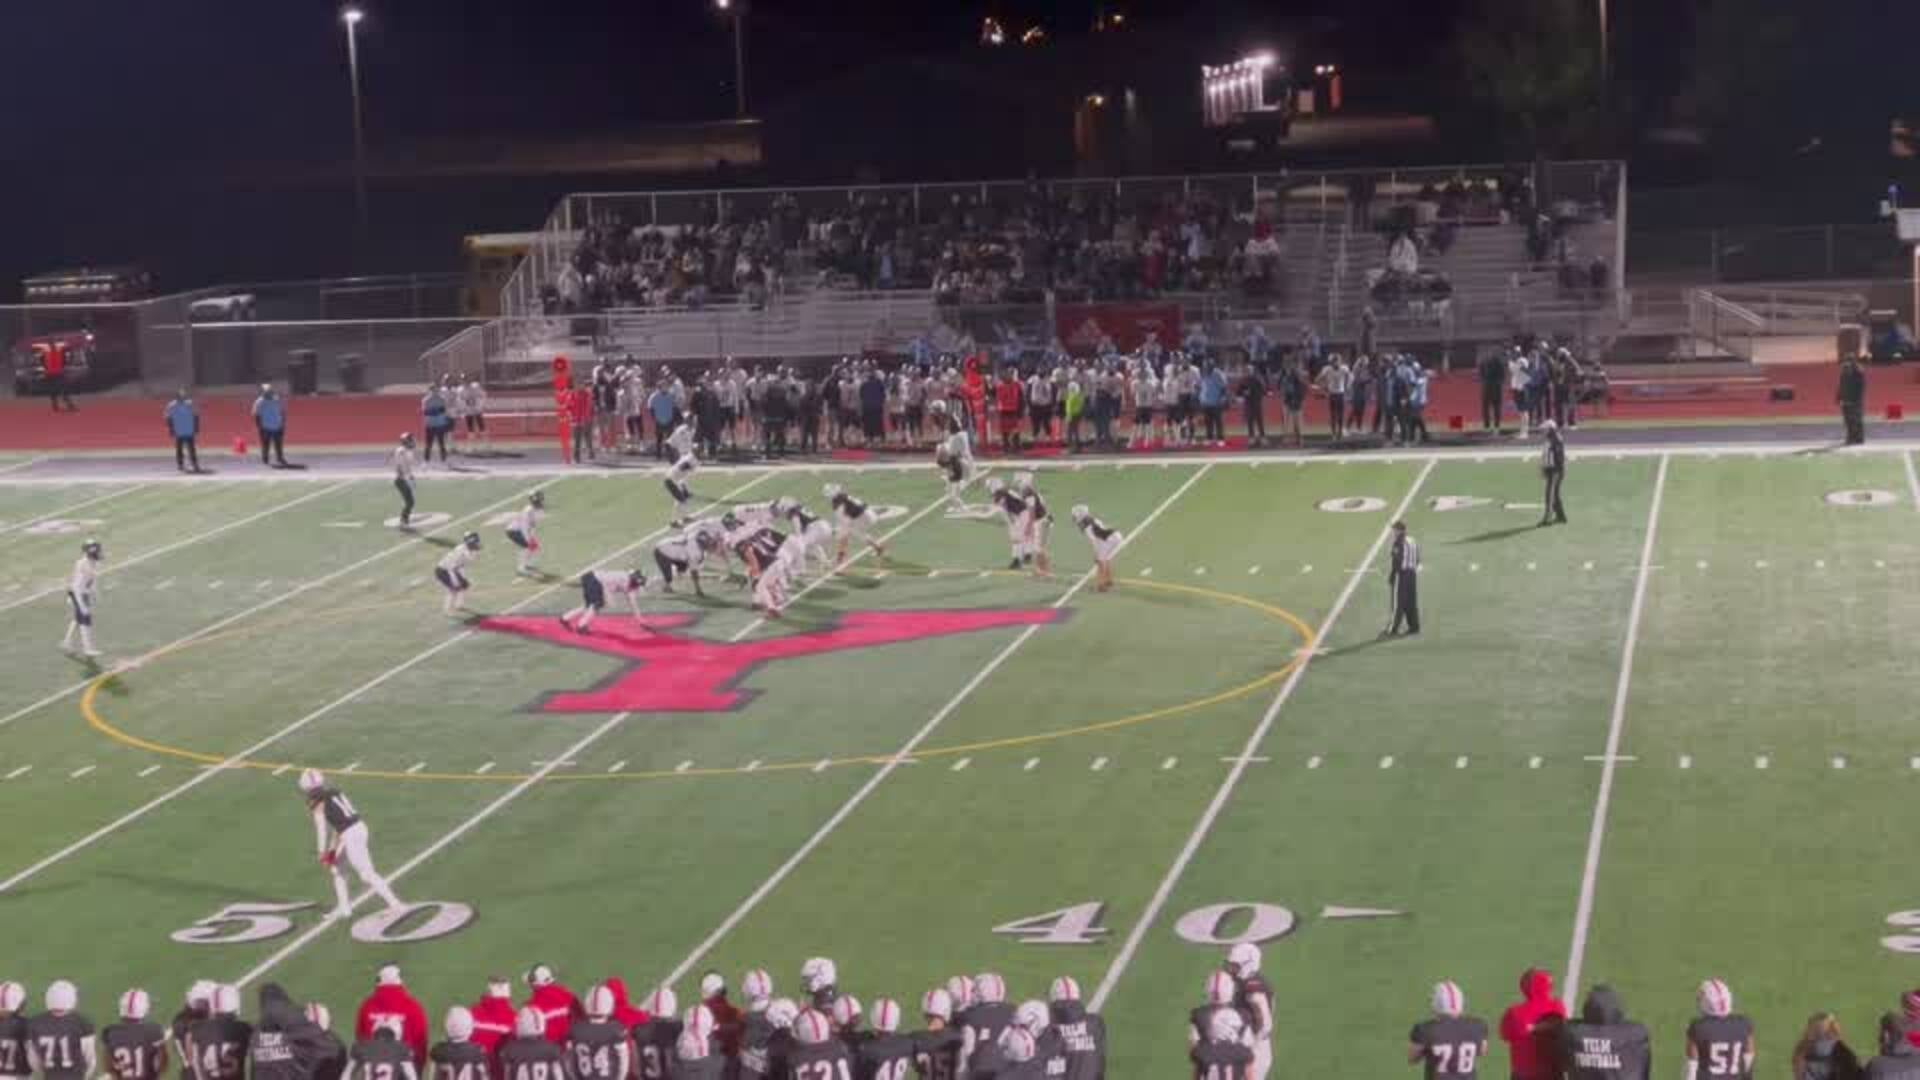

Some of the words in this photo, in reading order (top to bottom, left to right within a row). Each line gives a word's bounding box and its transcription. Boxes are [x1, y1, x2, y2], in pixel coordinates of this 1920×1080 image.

[39, 1036, 72, 1068] 71
[113, 1047, 144, 1078] 21
[576, 1043, 609, 1077] 64
[1432, 1042, 1477, 1073] 78
[1709, 1042, 1742, 1075] 51
